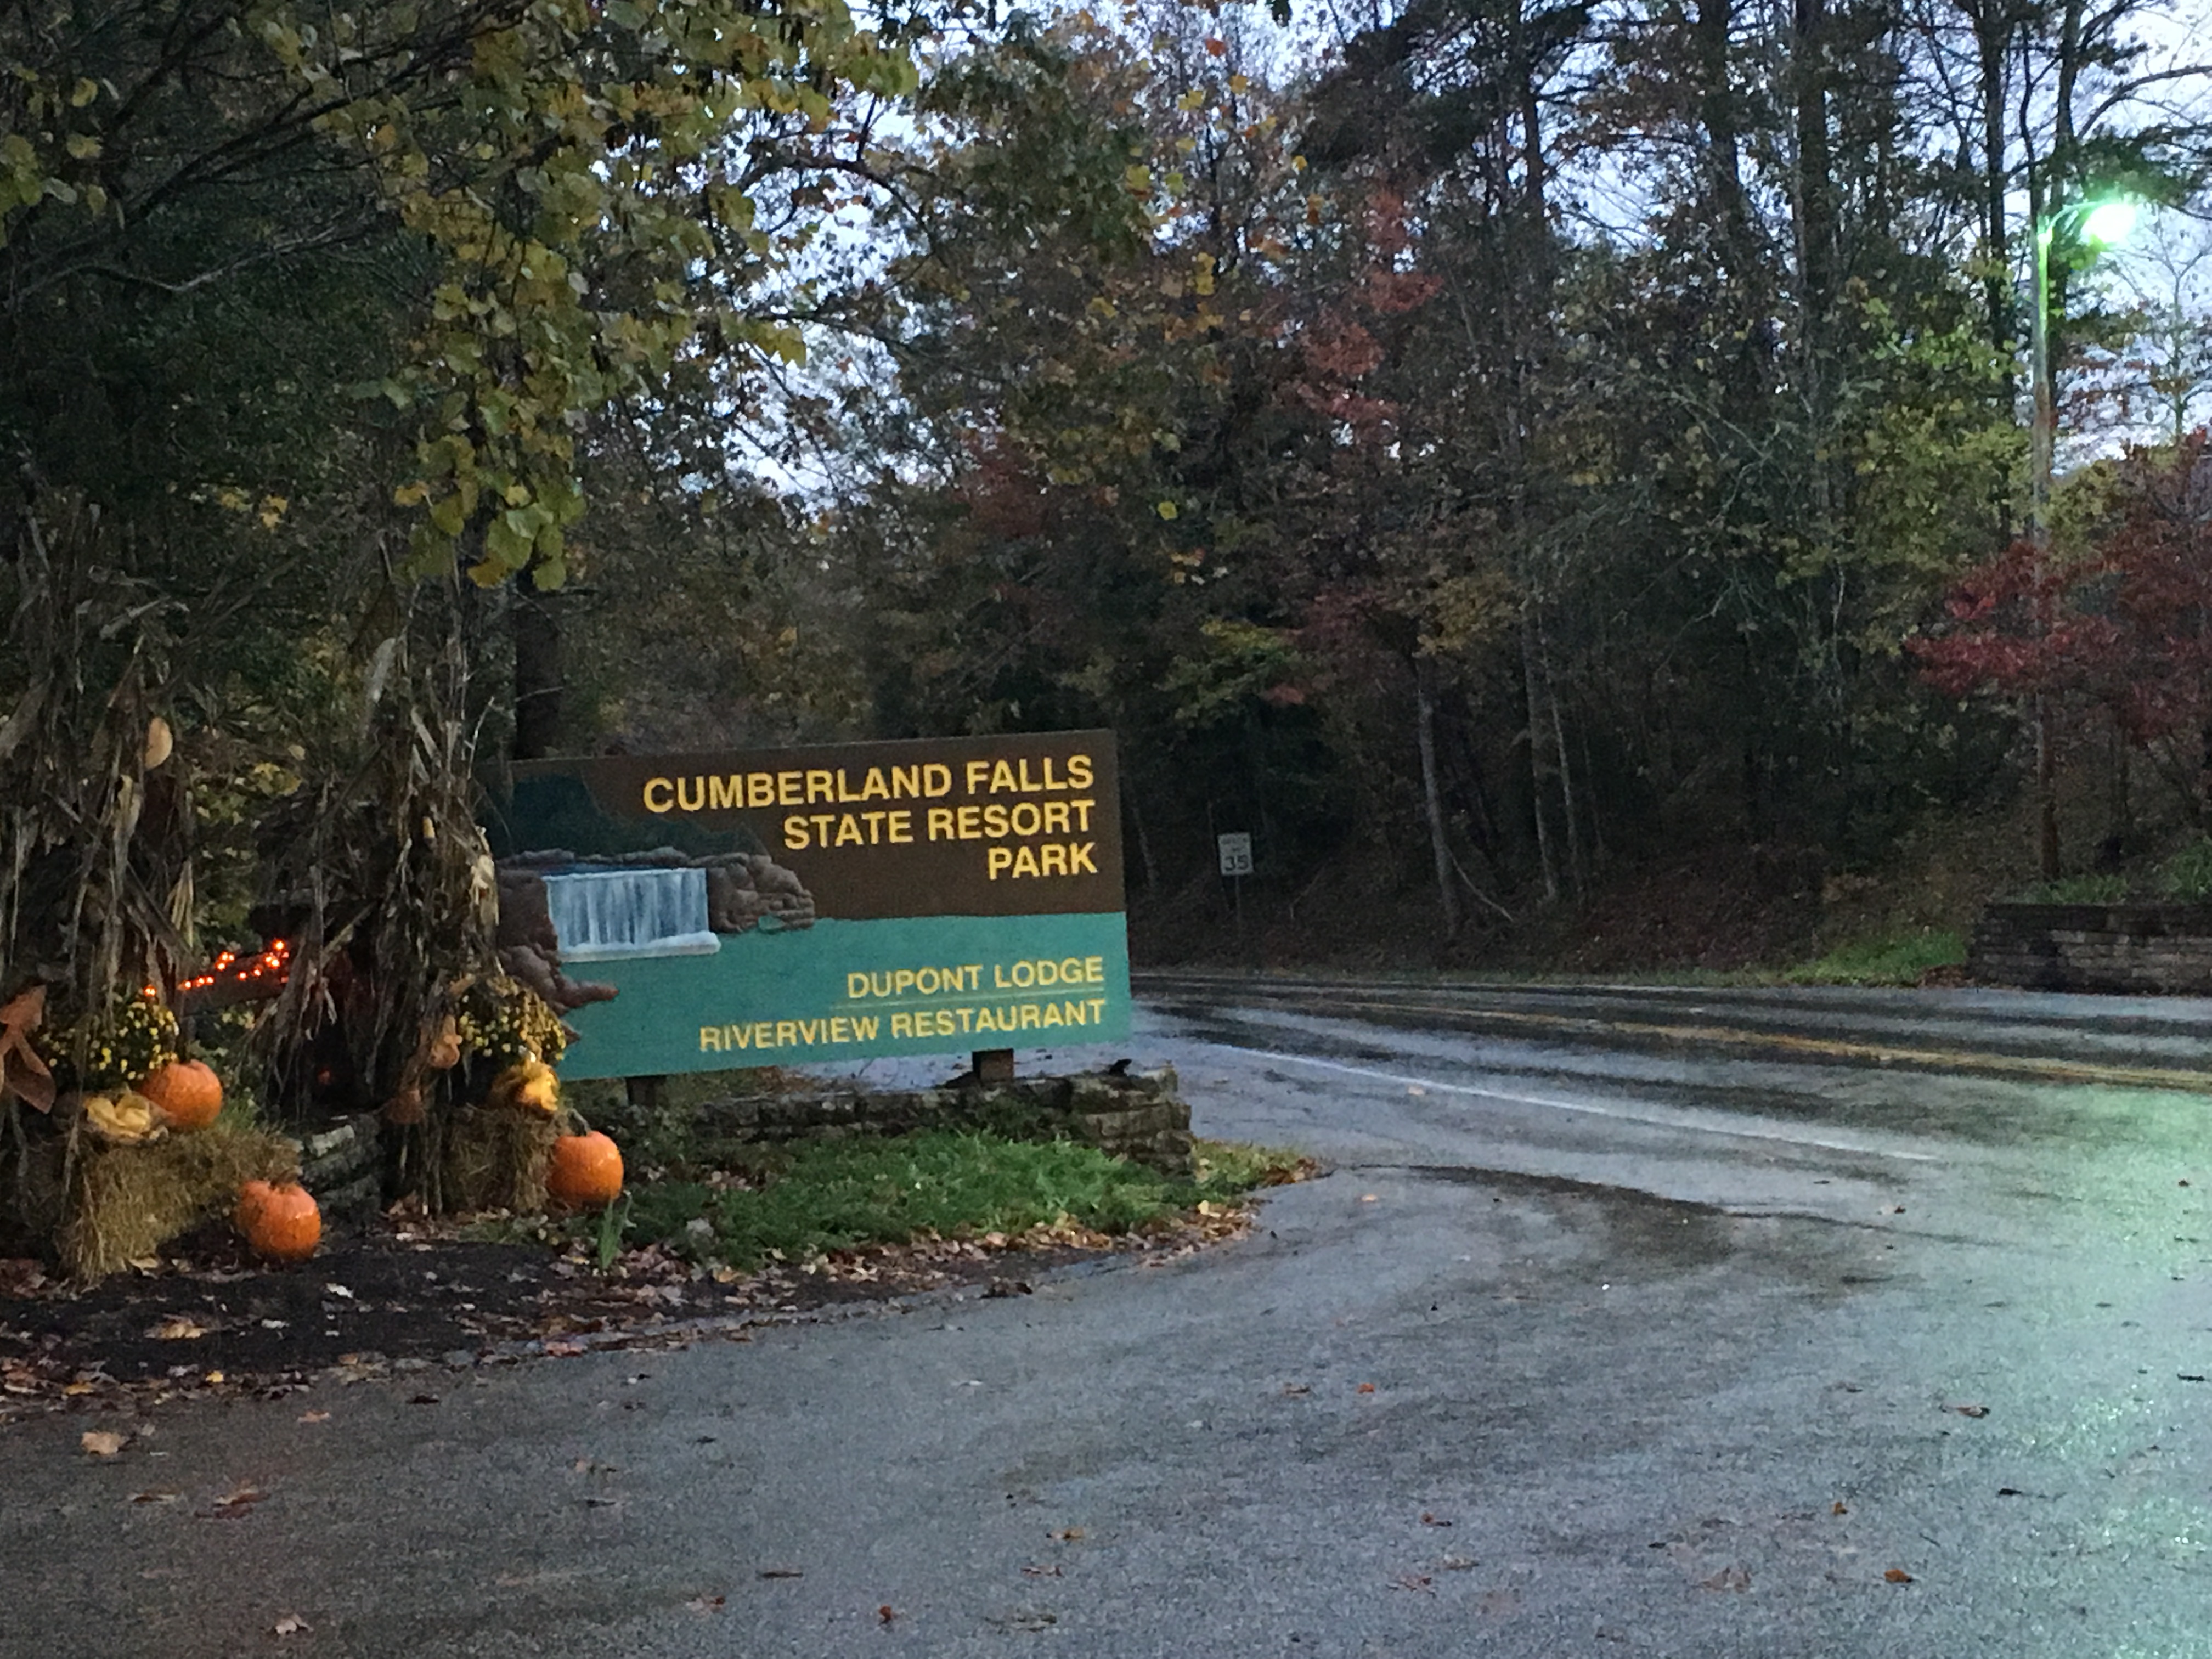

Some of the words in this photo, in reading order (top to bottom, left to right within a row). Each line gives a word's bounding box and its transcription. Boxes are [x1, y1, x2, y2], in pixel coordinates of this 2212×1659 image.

[643, 763, 952, 813] CUMBERLAND
[966, 754, 1094, 795] FALLS
[784, 810, 913, 850] STATE
[928, 799, 1096, 841] RESORT
[988, 842, 1098, 880] PARK
[1225, 854, 1249, 871] 35
[847, 964, 984, 999] DUPONT
[995, 956, 1104, 988] LODGE
[699, 1015, 879, 1052] RIVERVIEW
[891, 999, 1105, 1039] RESTAURANT
